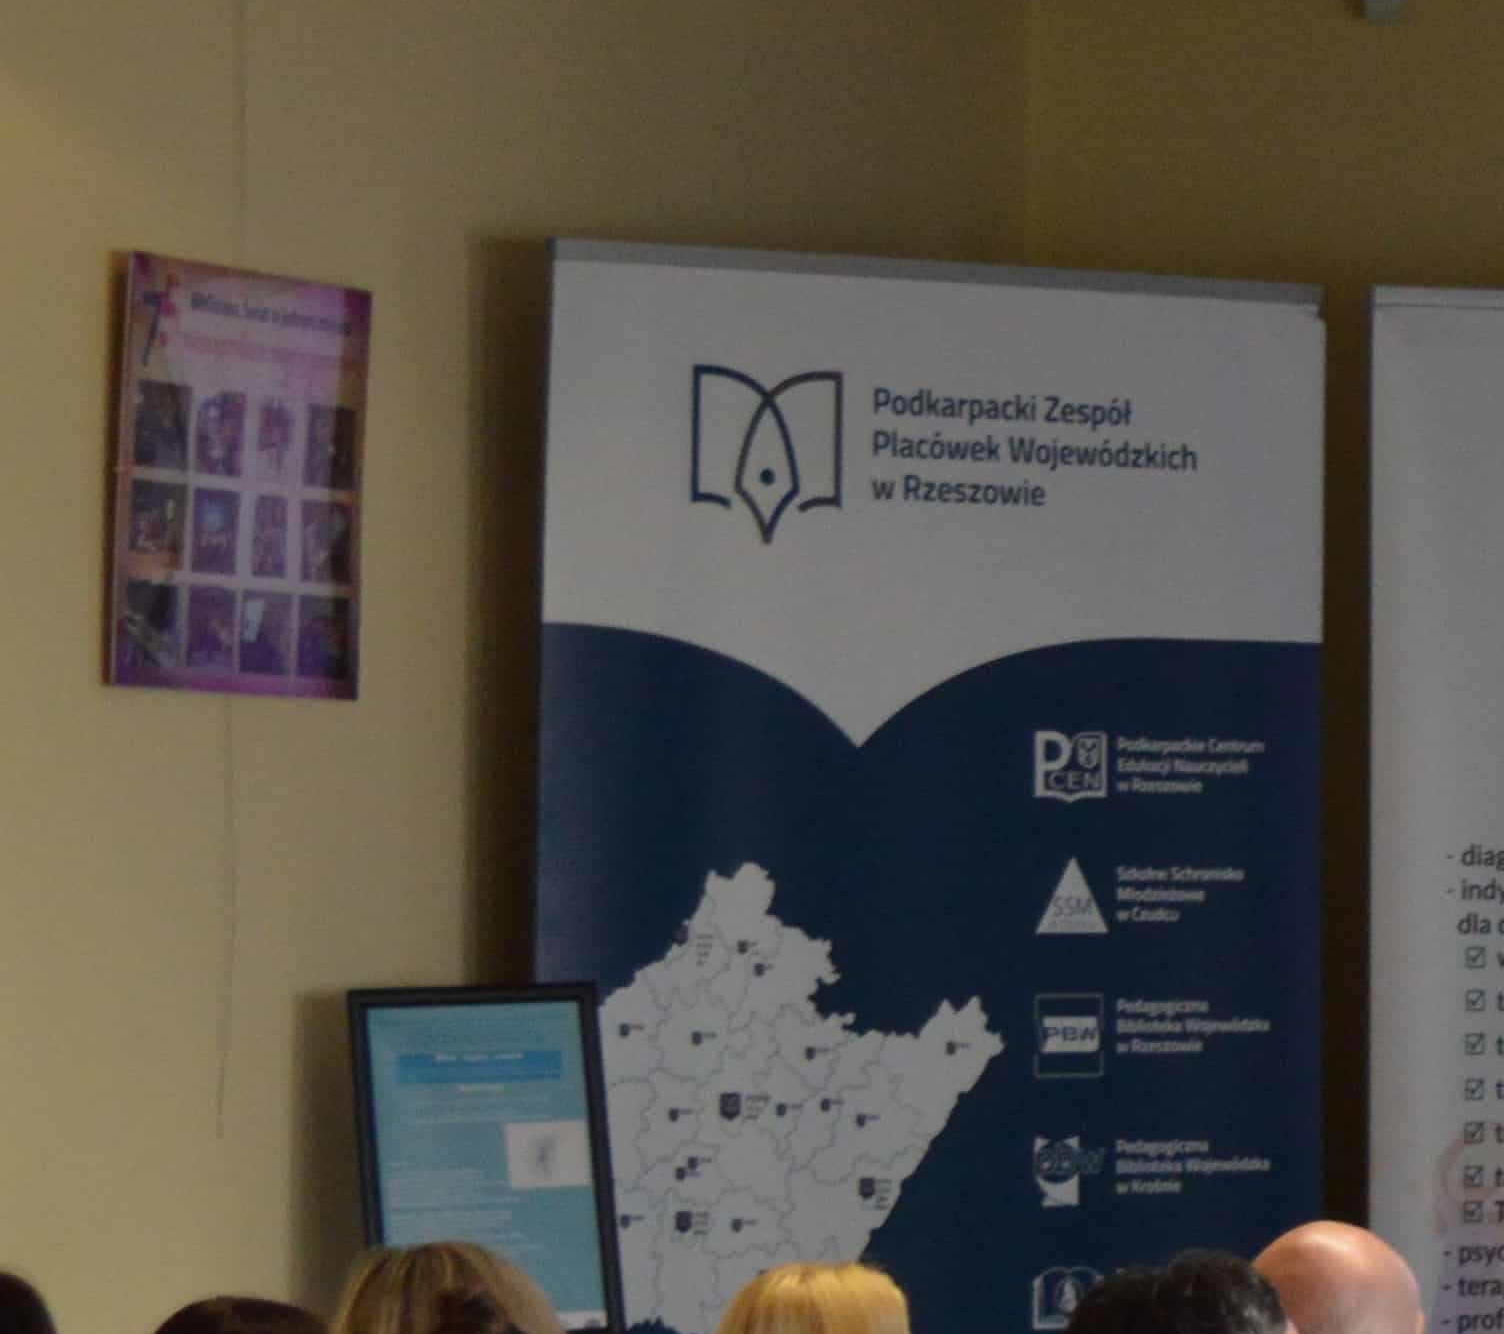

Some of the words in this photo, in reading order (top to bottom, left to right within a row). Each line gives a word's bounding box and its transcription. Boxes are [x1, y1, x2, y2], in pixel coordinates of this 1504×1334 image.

[872, 386, 1037, 426] Podkarpacki
[1045, 396, 1132, 432] Zespół
[872, 431, 1002, 462] Placówek
[1007, 437, 1198, 471] Wojewódzkich
[873, 482, 894, 501] w
[904, 475, 1047, 507] Rzeszowie
[1457, 913, 1491, 937] dla
